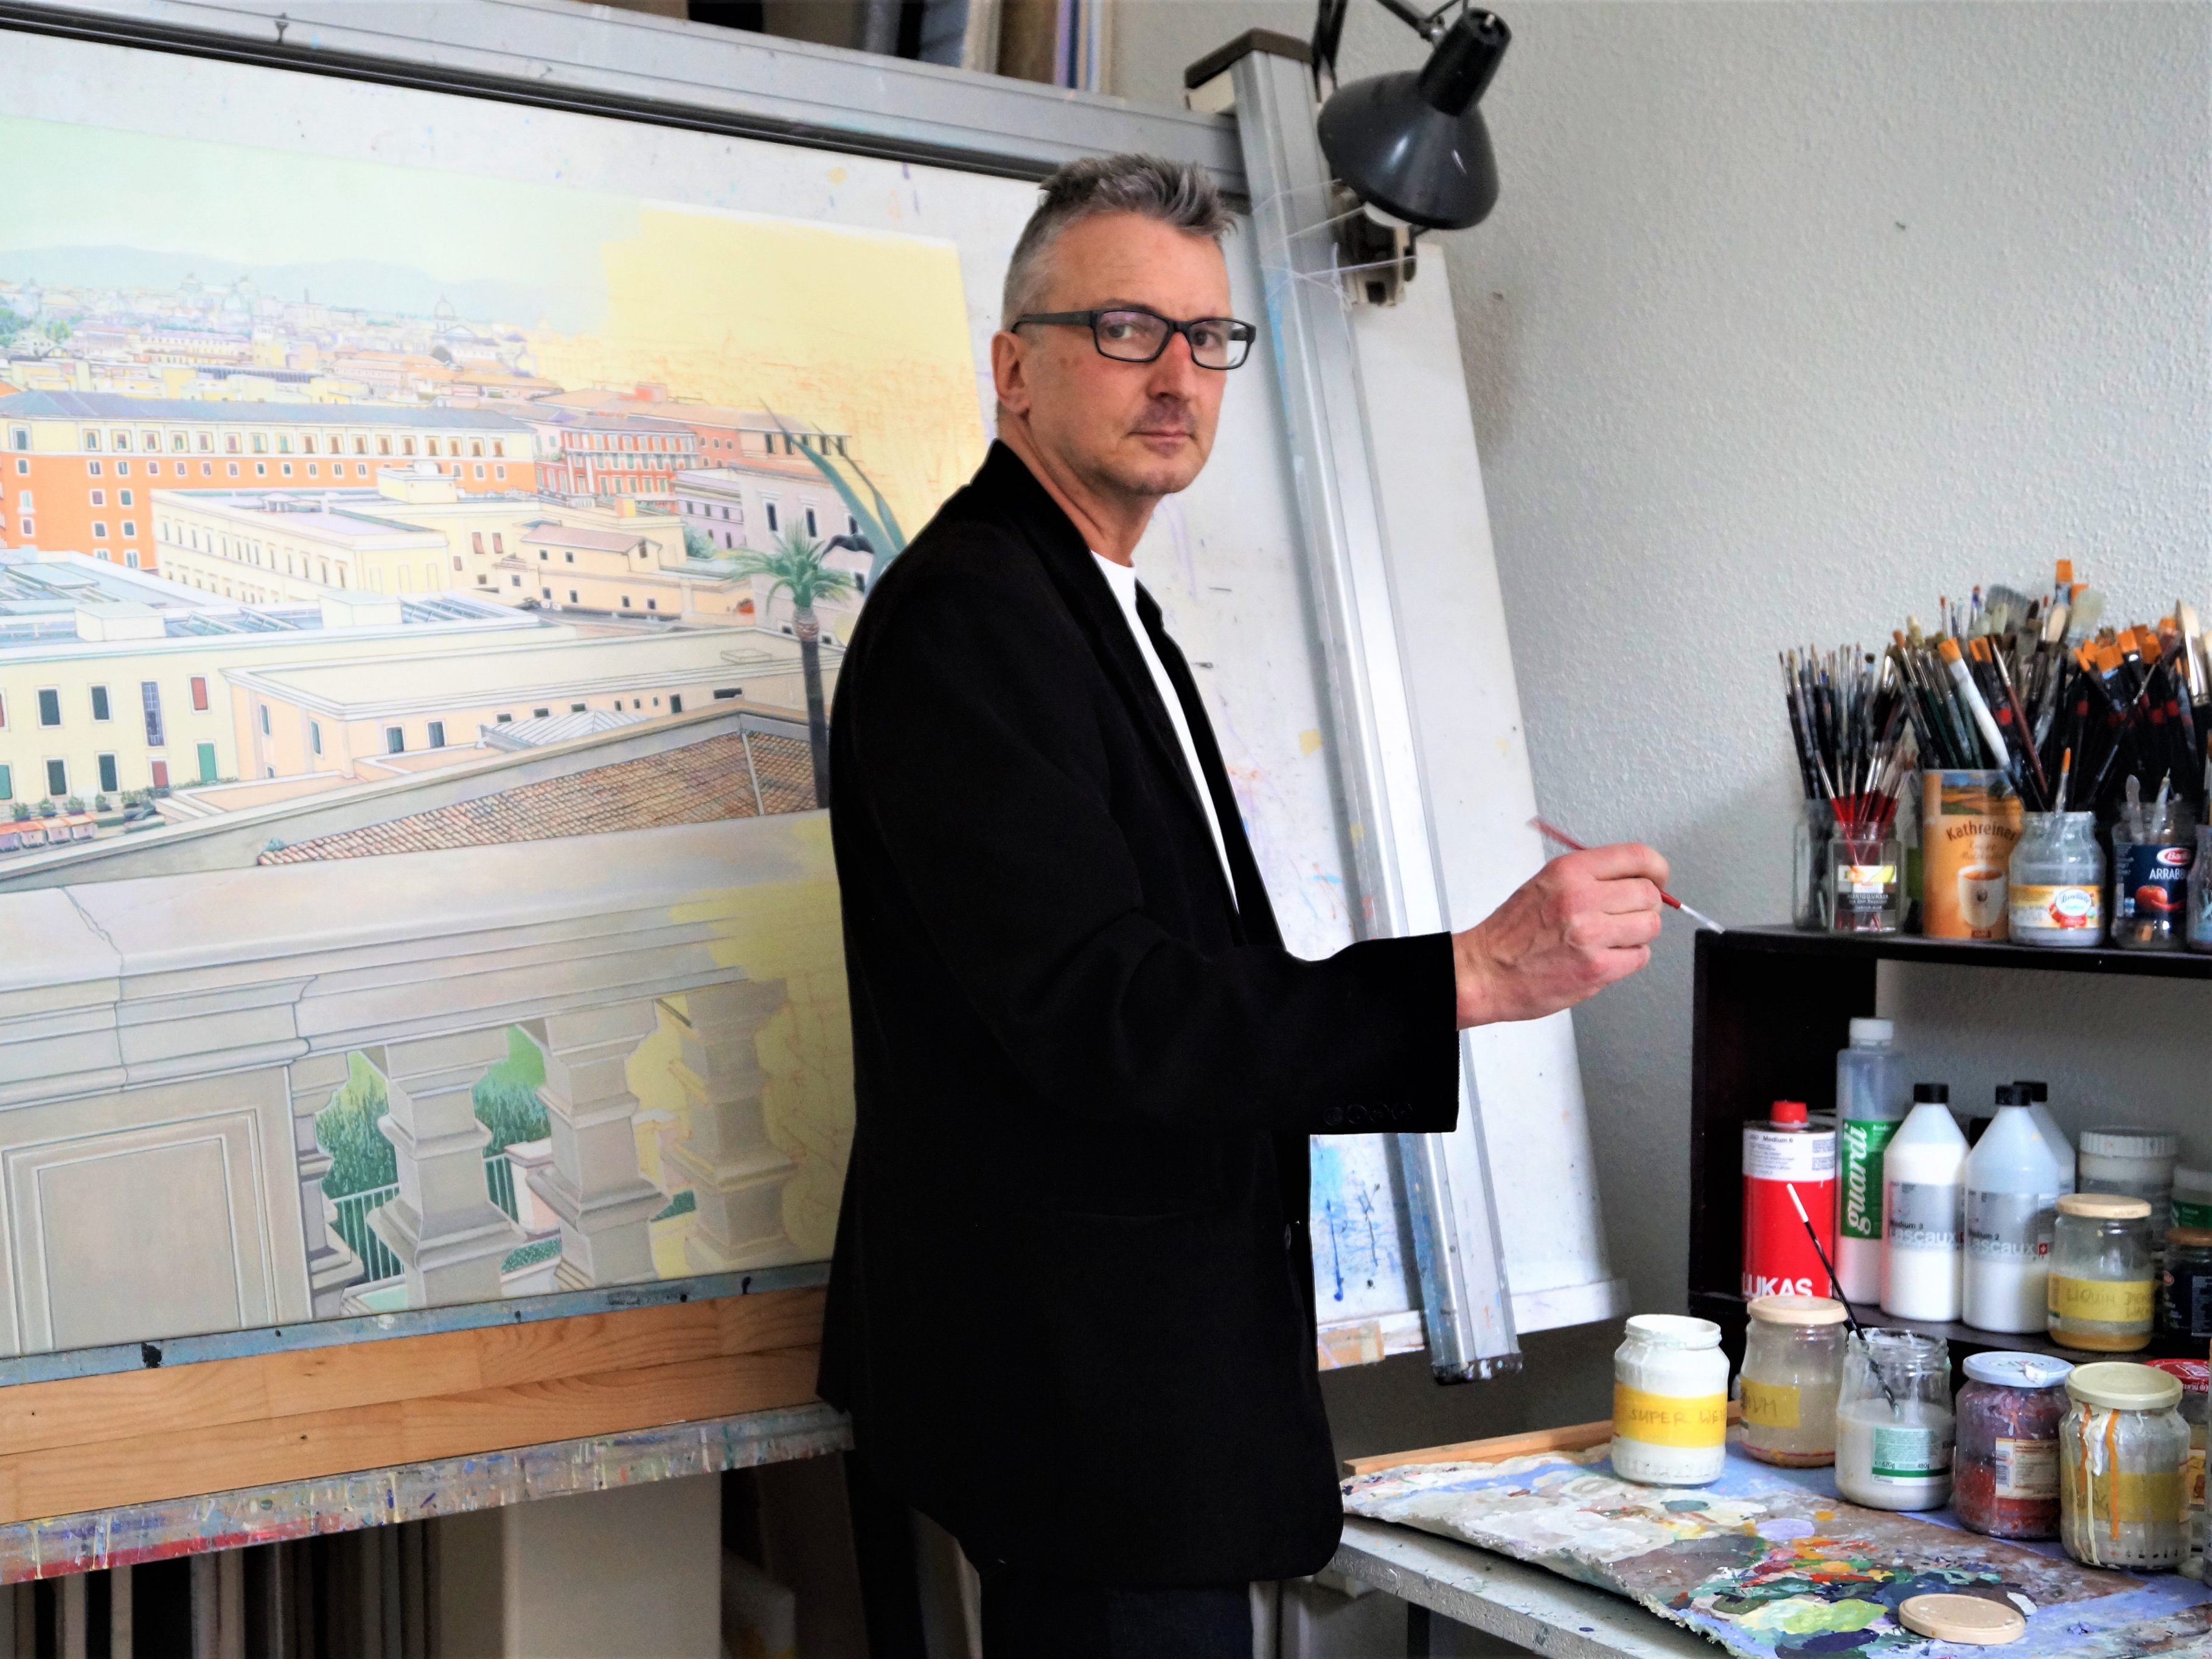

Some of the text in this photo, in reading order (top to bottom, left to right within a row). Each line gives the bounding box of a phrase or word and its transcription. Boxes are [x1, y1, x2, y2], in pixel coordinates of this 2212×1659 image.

[1947, 821, 2016, 841] Kathreiner
[1844, 1122, 1871, 1235] guardi
[1742, 1273, 1813, 1298] LUKAS
[1630, 1407, 1690, 1425] SUPER
